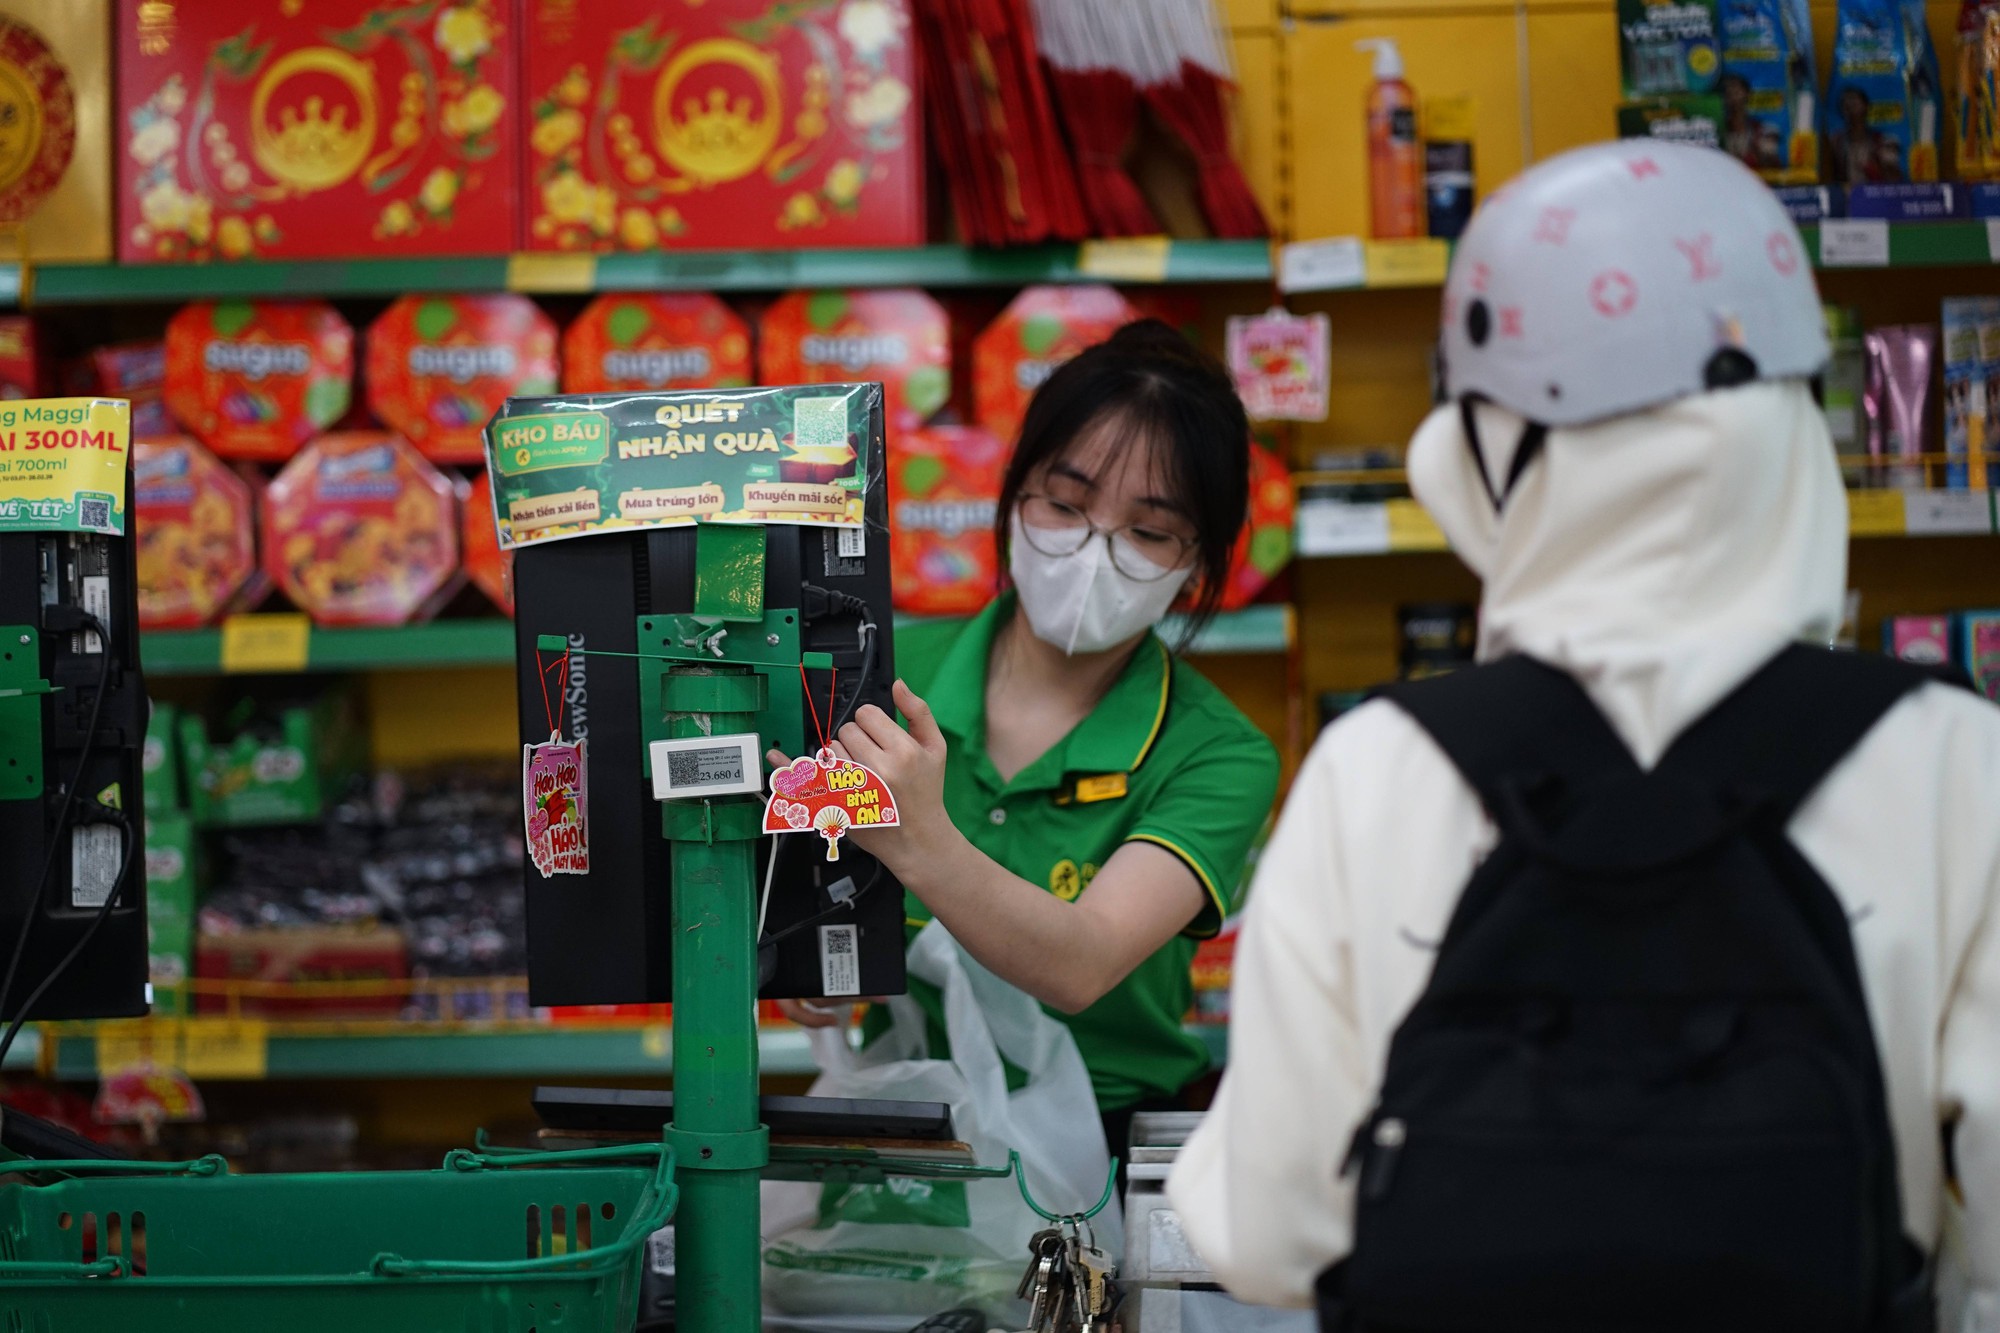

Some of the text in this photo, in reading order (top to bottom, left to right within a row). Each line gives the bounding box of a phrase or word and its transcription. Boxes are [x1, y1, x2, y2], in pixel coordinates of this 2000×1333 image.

[24, 404, 89, 424] Maggi
[25, 429, 122, 452] 300ML
[502, 420, 600, 449] KHO BÁU
[618, 427, 780, 460] NHẬN QUÀ
[16, 458, 67, 472] 700ml
[625, 499, 653, 509] Mua
[656, 495, 696, 509] trúng
[748, 488, 843, 505] Khuyến mãi sốc
[565, 633, 589, 745] ewSonic
[700, 770, 732, 781] 23.680
[828, 762, 866, 791] HẢO
[846, 788, 880, 807] BÌNH
[856, 804, 881, 825] AN
[551, 816, 578, 855] HẢO
